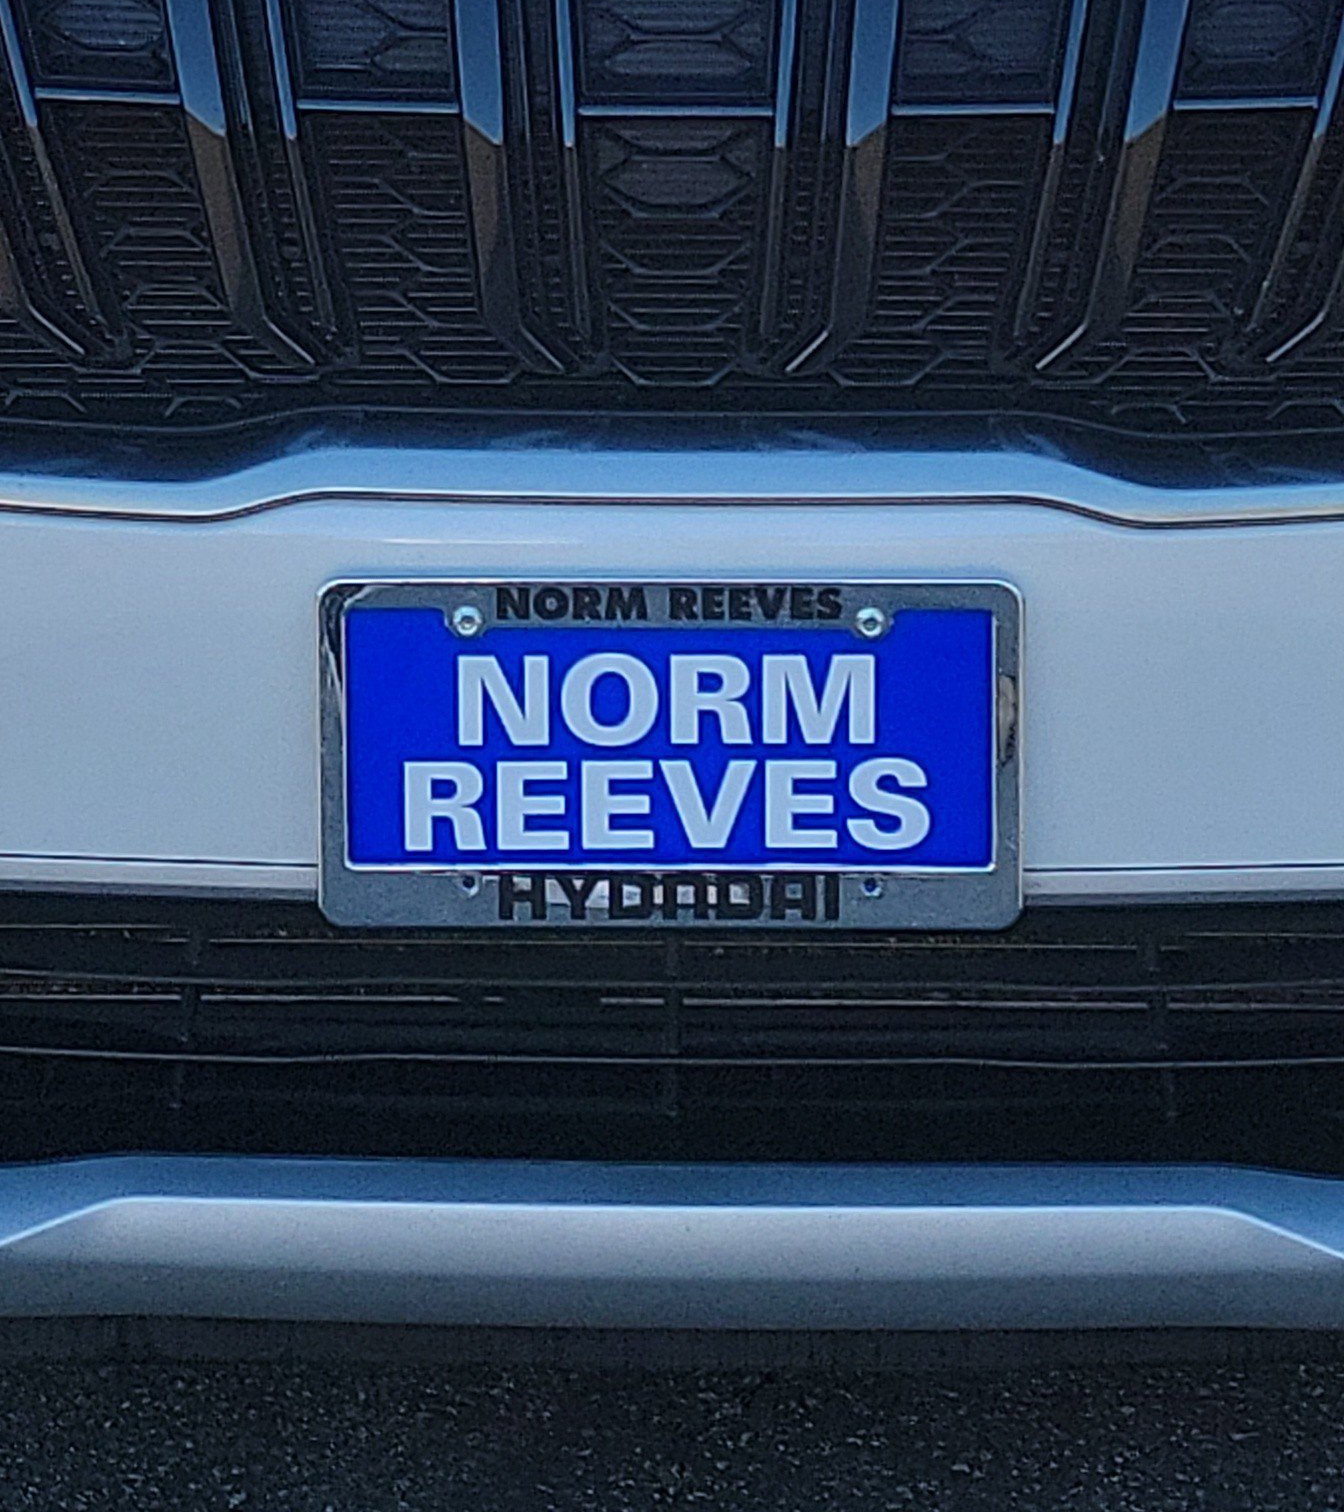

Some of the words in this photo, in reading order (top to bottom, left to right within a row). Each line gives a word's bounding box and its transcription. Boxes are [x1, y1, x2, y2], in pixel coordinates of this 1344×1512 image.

[496, 587, 650, 621] NORM
[668, 587, 843, 621] REEVES
[457, 653, 877, 748] NORM
[403, 758, 932, 853] REEVES
